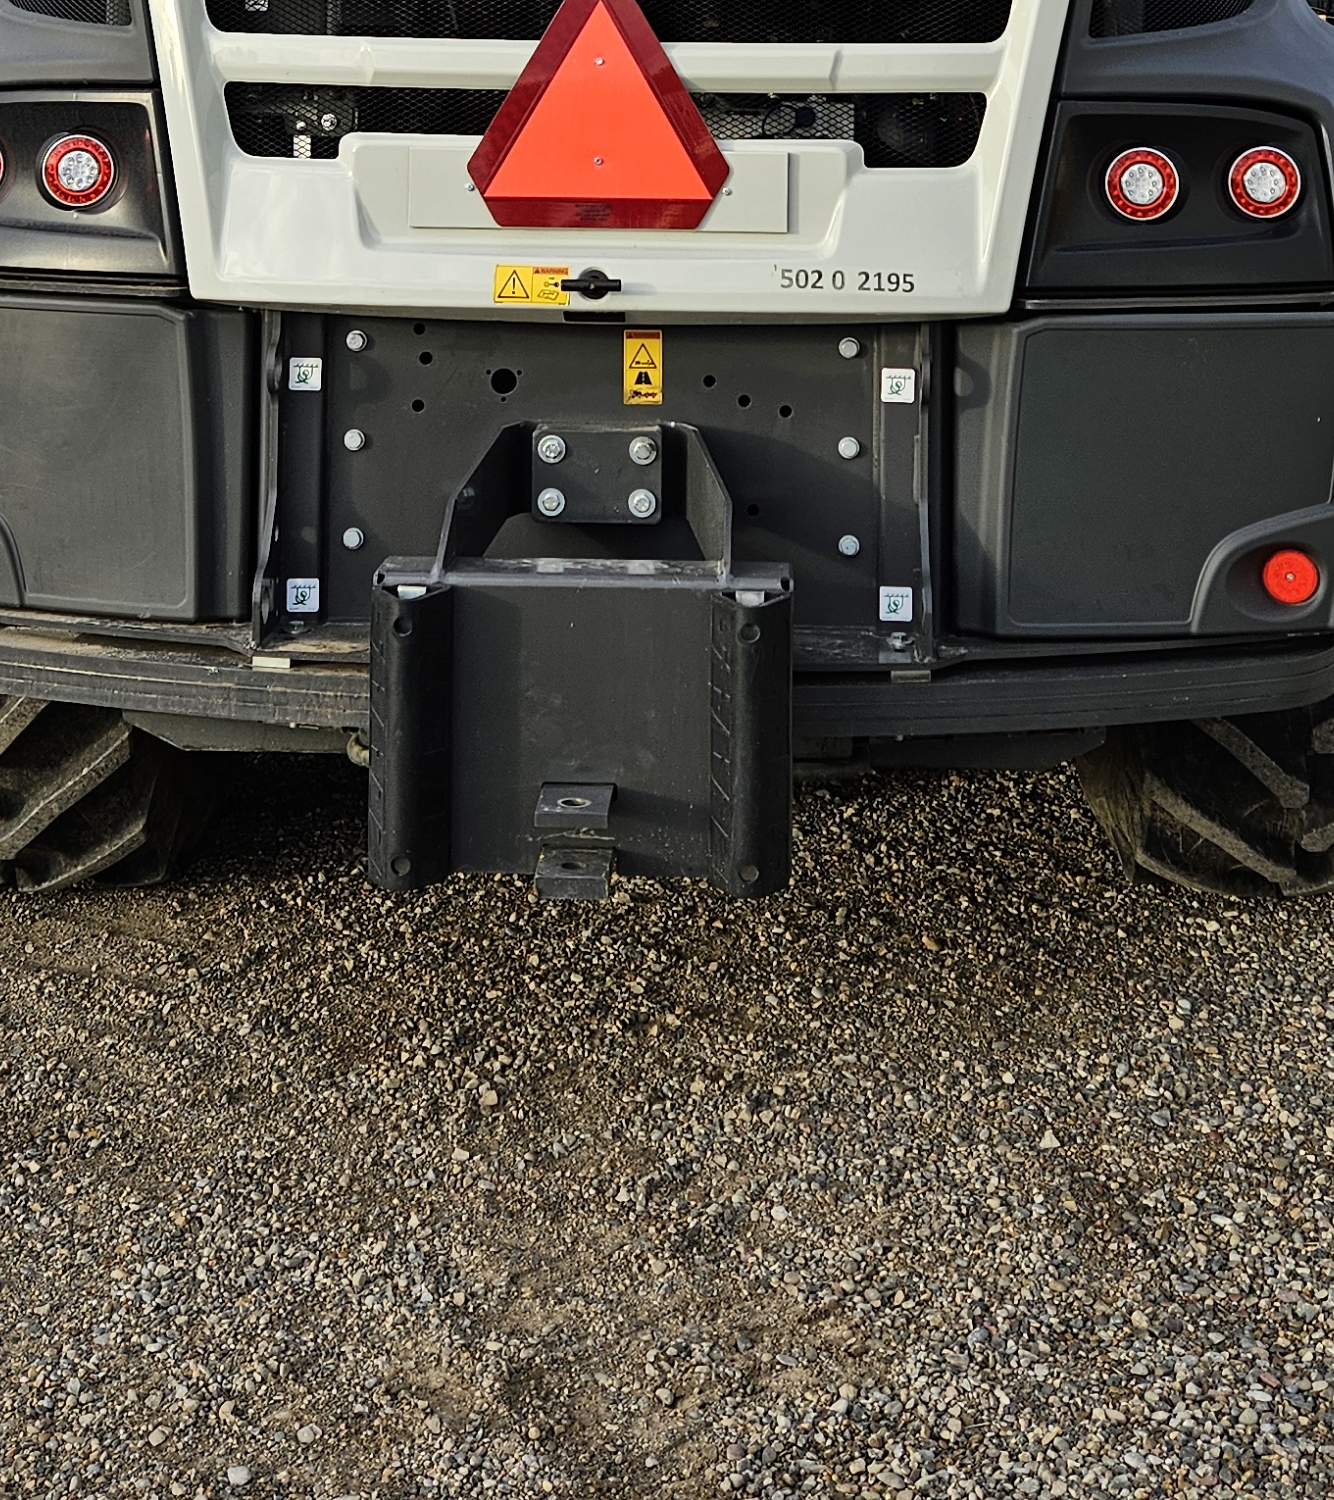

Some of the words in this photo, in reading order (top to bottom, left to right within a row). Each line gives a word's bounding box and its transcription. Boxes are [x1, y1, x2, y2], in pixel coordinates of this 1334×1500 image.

[780, 268, 824, 289] 502
[831, 270, 846, 290] 0
[857, 271, 915, 293] 2195
